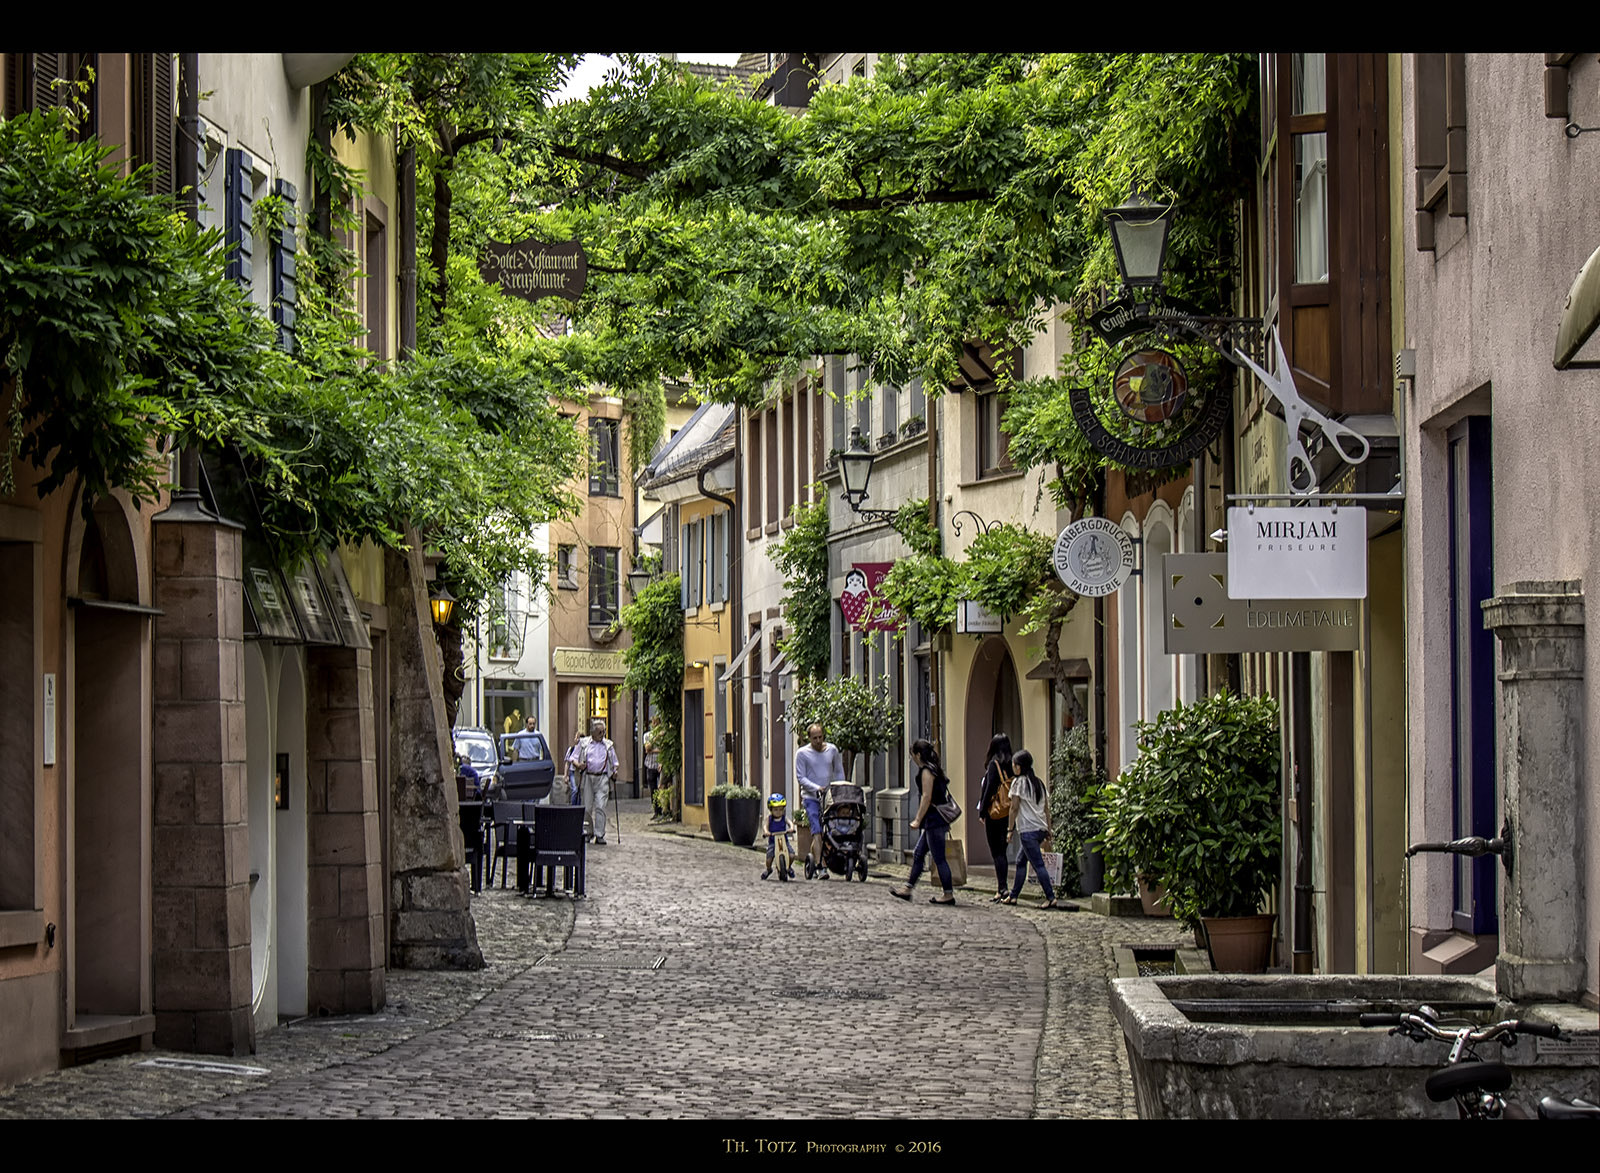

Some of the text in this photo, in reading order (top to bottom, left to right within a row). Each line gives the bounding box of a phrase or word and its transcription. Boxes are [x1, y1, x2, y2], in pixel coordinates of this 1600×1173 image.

[1072, 390, 1098, 437] HOTEL
[1256, 521, 1338, 540] MIRJAM
[1057, 519, 1133, 571] GUTENBERGDRUCKEREI
[1257, 543, 1337, 552] FRISEURE
[1070, 578, 1121, 596] PAPETERIE
[1246, 610, 1353, 629] EDELMETALLE
